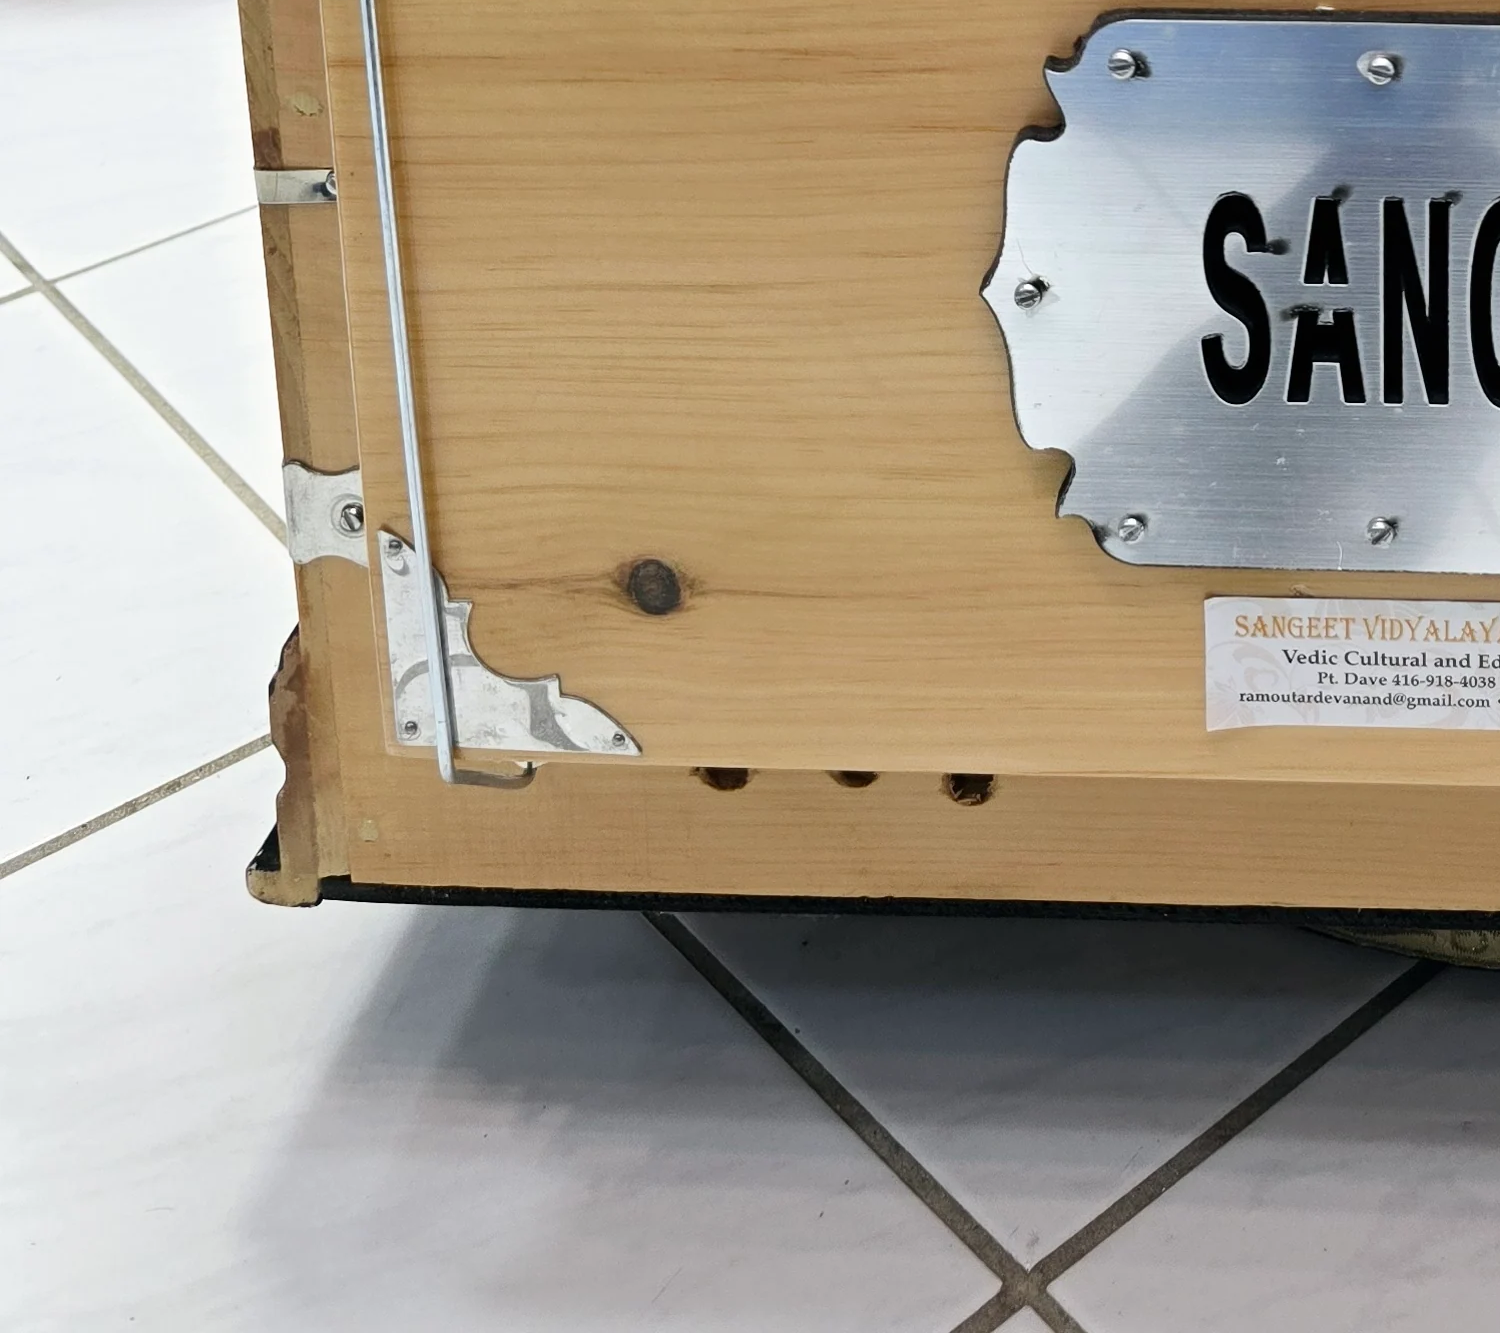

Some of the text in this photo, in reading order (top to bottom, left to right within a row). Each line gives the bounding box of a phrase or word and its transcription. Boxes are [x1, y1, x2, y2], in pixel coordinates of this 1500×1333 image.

[1234, 614, 1357, 640] SANGEET
[1282, 648, 1339, 666] Vedic
[1343, 650, 1428, 668] Cultural
[1433, 653, 1472, 669] and
[1317, 671, 1339, 685] Pt.
[1343, 671, 1388, 686] Dave
[1391, 673, 1497, 689] 416-918-4038
[1238, 689, 1491, 710] ramoutardevanand@gmail.com
